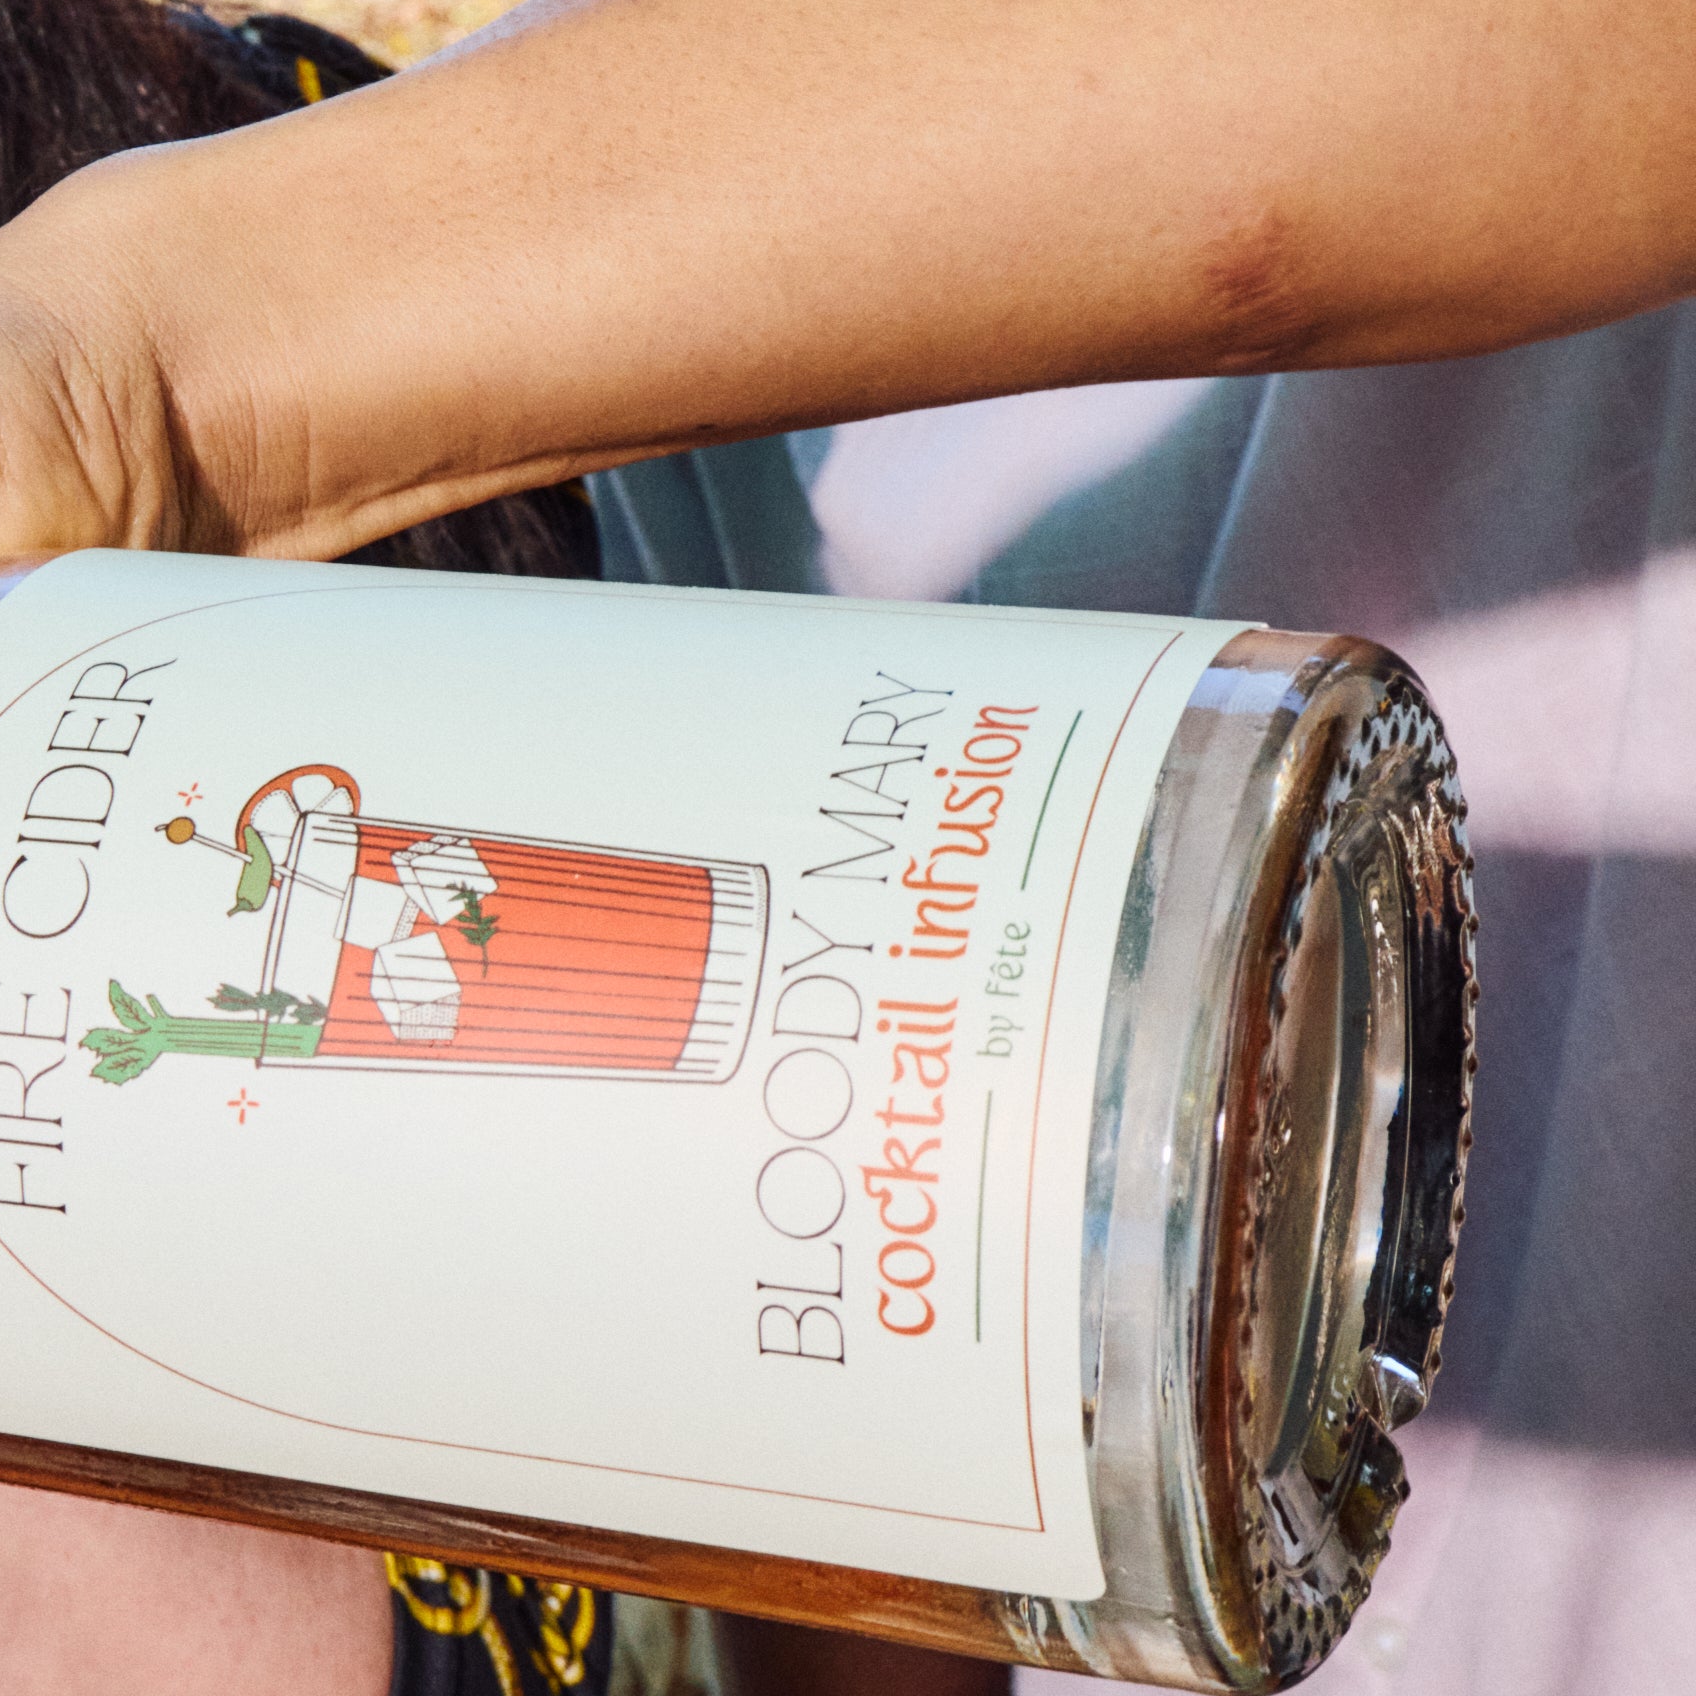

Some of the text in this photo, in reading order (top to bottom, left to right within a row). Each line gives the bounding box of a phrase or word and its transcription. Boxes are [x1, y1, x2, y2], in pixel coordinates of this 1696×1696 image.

[1, 657, 178, 941] CIDER
[755, 670, 953, 1365] BLOODY MARY
[860, 704, 1040, 1338] cocktail infusion
[977, 1015, 1025, 1059] by
